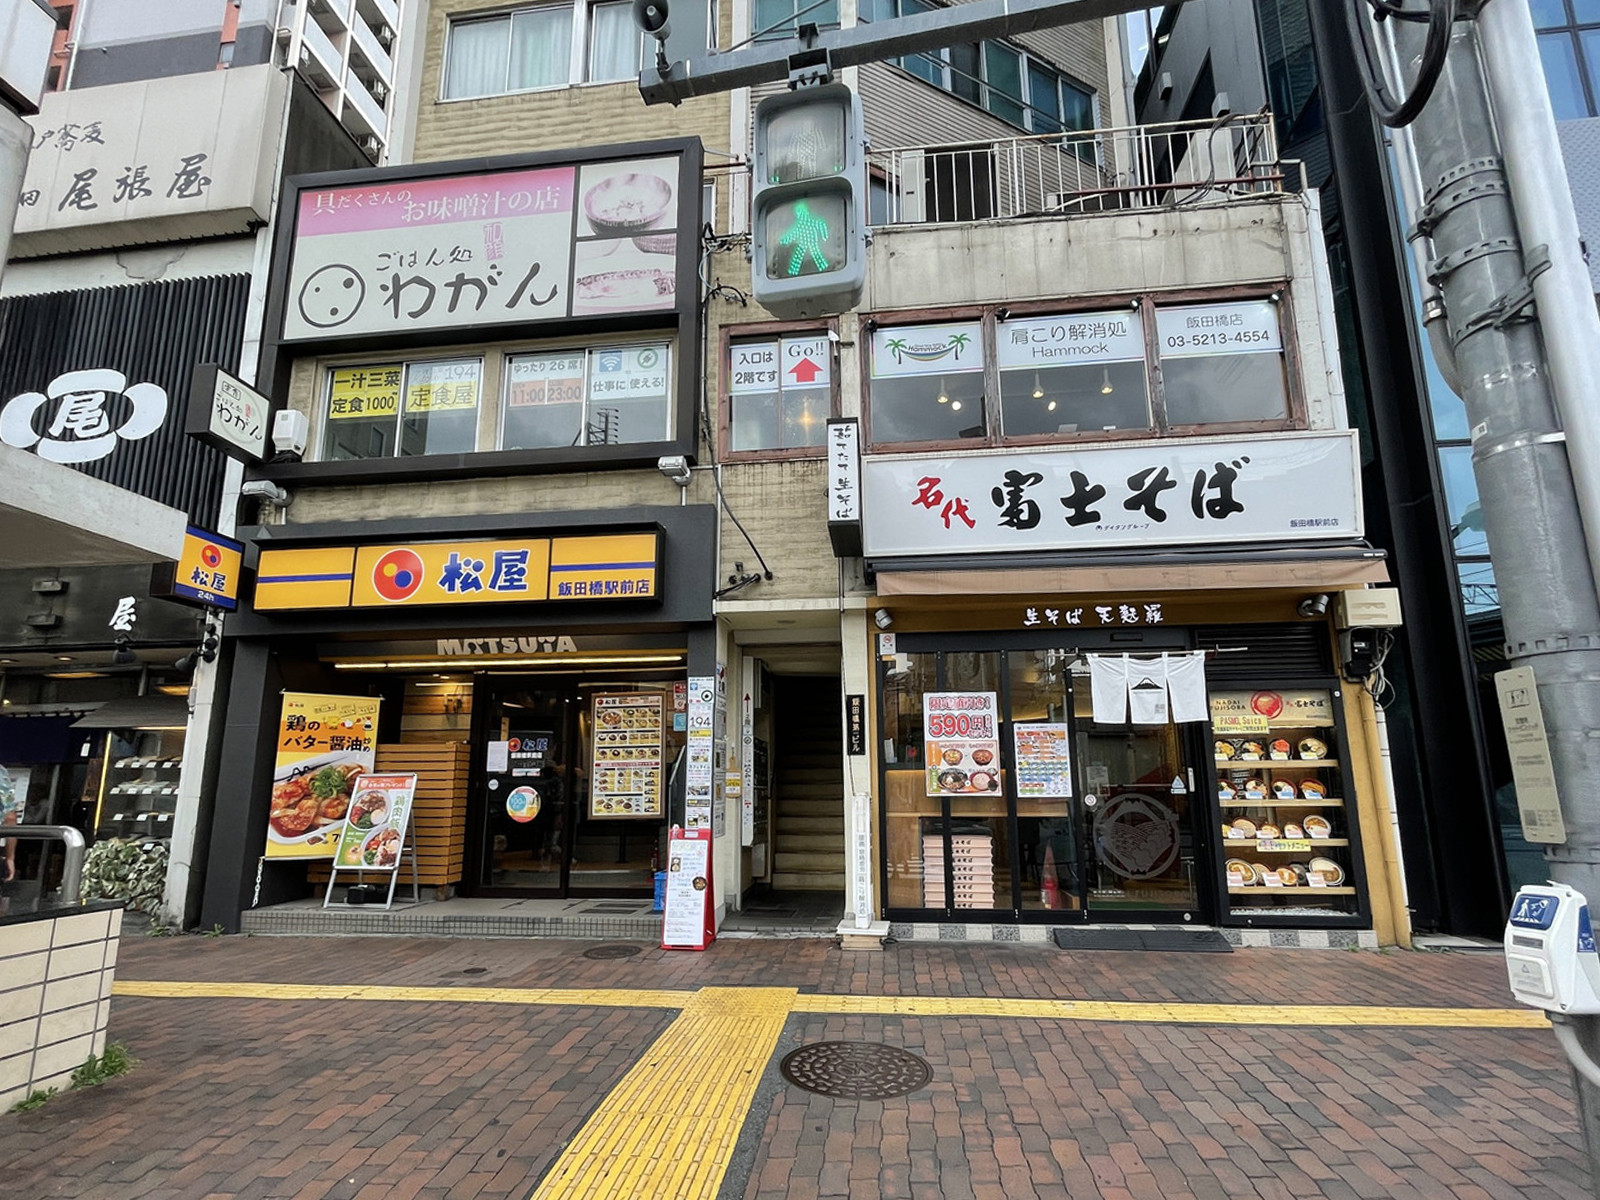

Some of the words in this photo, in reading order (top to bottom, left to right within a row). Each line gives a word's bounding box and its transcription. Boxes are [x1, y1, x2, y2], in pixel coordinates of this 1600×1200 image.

[32, 121, 105, 151] 戸蕎麦
[313, 190, 411, 215] 具だくさんの
[401, 186, 560, 222] お味噌汁の店
[376, 244, 473, 272] ごはん処
[380, 262, 559, 320] わがん
[1186, 313, 1244, 329] 飯田橋店
[1010, 321, 1127, 345] 肩こり解消処
[1167, 330, 1270, 348] 03-5213-4554
[739, 351, 774, 365] 入口は
[788, 341, 824, 358] Go!!
[1032, 342, 1110, 358] Hammock
[335, 371, 400, 389] 一汁三菜
[735, 370, 777, 384] 2階です
[410, 382, 474, 408] 定食屋
[217, 403, 262, 440] わがん
[910, 475, 976, 530] 名代
[990, 455, 1251, 531] 富士そば
[191, 566, 226, 592] 松屋
[437, 549, 530, 594] 松屋
[557, 579, 650, 597] 飯田橋駅前店
[1023, 607, 1084, 626] 生そば
[286, 715, 320, 732] 鶏の
